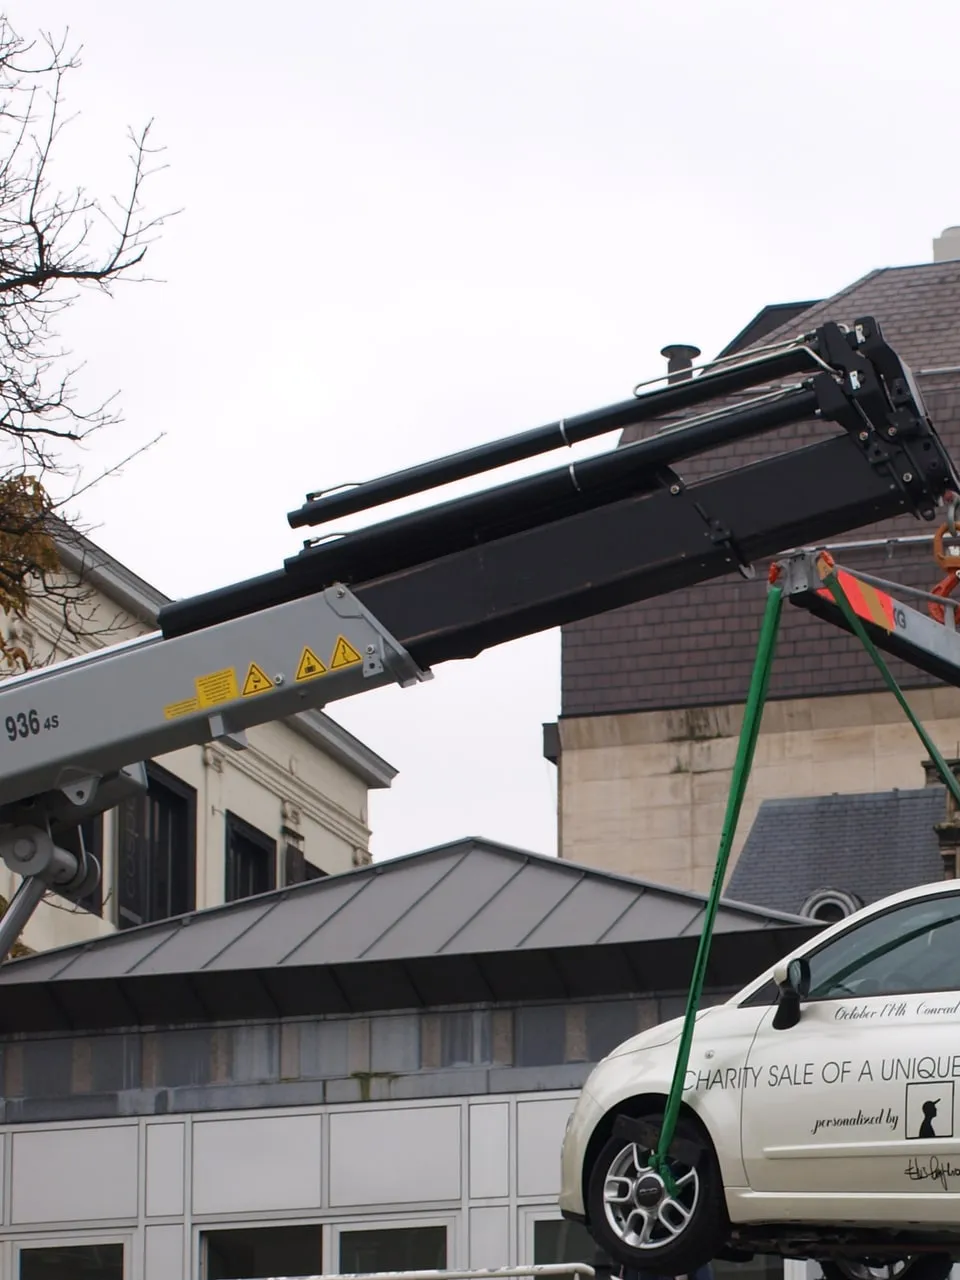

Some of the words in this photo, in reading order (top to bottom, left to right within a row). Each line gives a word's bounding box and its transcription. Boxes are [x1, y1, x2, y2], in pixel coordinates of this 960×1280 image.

[5, 709, 40, 742] 936
[43, 714, 59, 731] 4S
[834, 1005, 878, 1021] October
[916, 1000, 960, 1015] Conrad
[682, 1066, 763, 1091] CHARITY
[768, 1063, 815, 1087] SALE
[821, 1061, 852, 1084] OF
[858, 1060, 873, 1082] A
[811, 1108, 885, 1135] personalized
[885, 1107, 899, 1131] by
